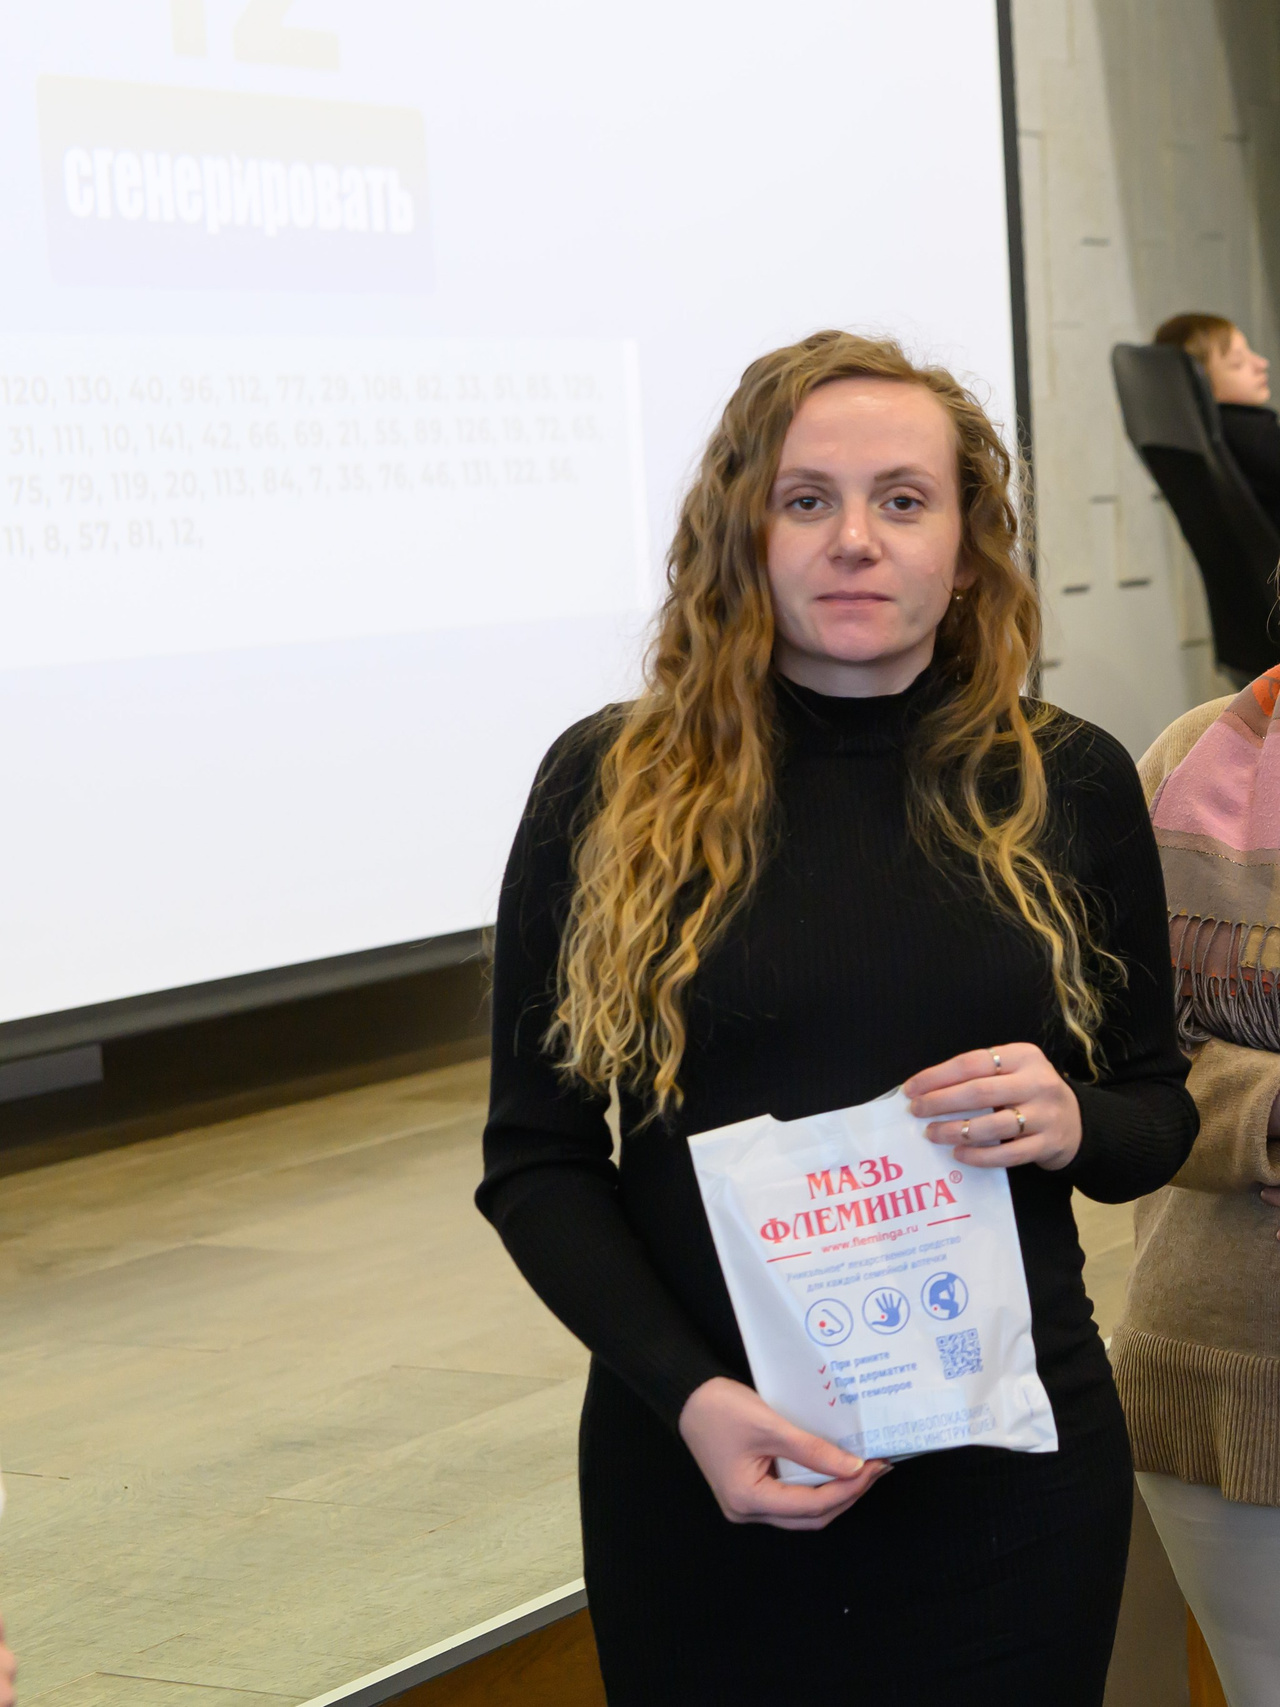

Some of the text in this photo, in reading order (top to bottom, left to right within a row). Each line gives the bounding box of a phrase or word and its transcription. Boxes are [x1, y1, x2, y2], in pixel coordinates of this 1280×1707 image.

[63, 145, 416, 238] сгенерировать
[806, 1155, 904, 1200] МАЗЬ
[821, 1224, 919, 1254] www.fleminga.ru
[830, 1351, 890, 1373] При рините
[859, 1362, 918, 1384] дерматите
[861, 1380, 913, 1399] геморрое
